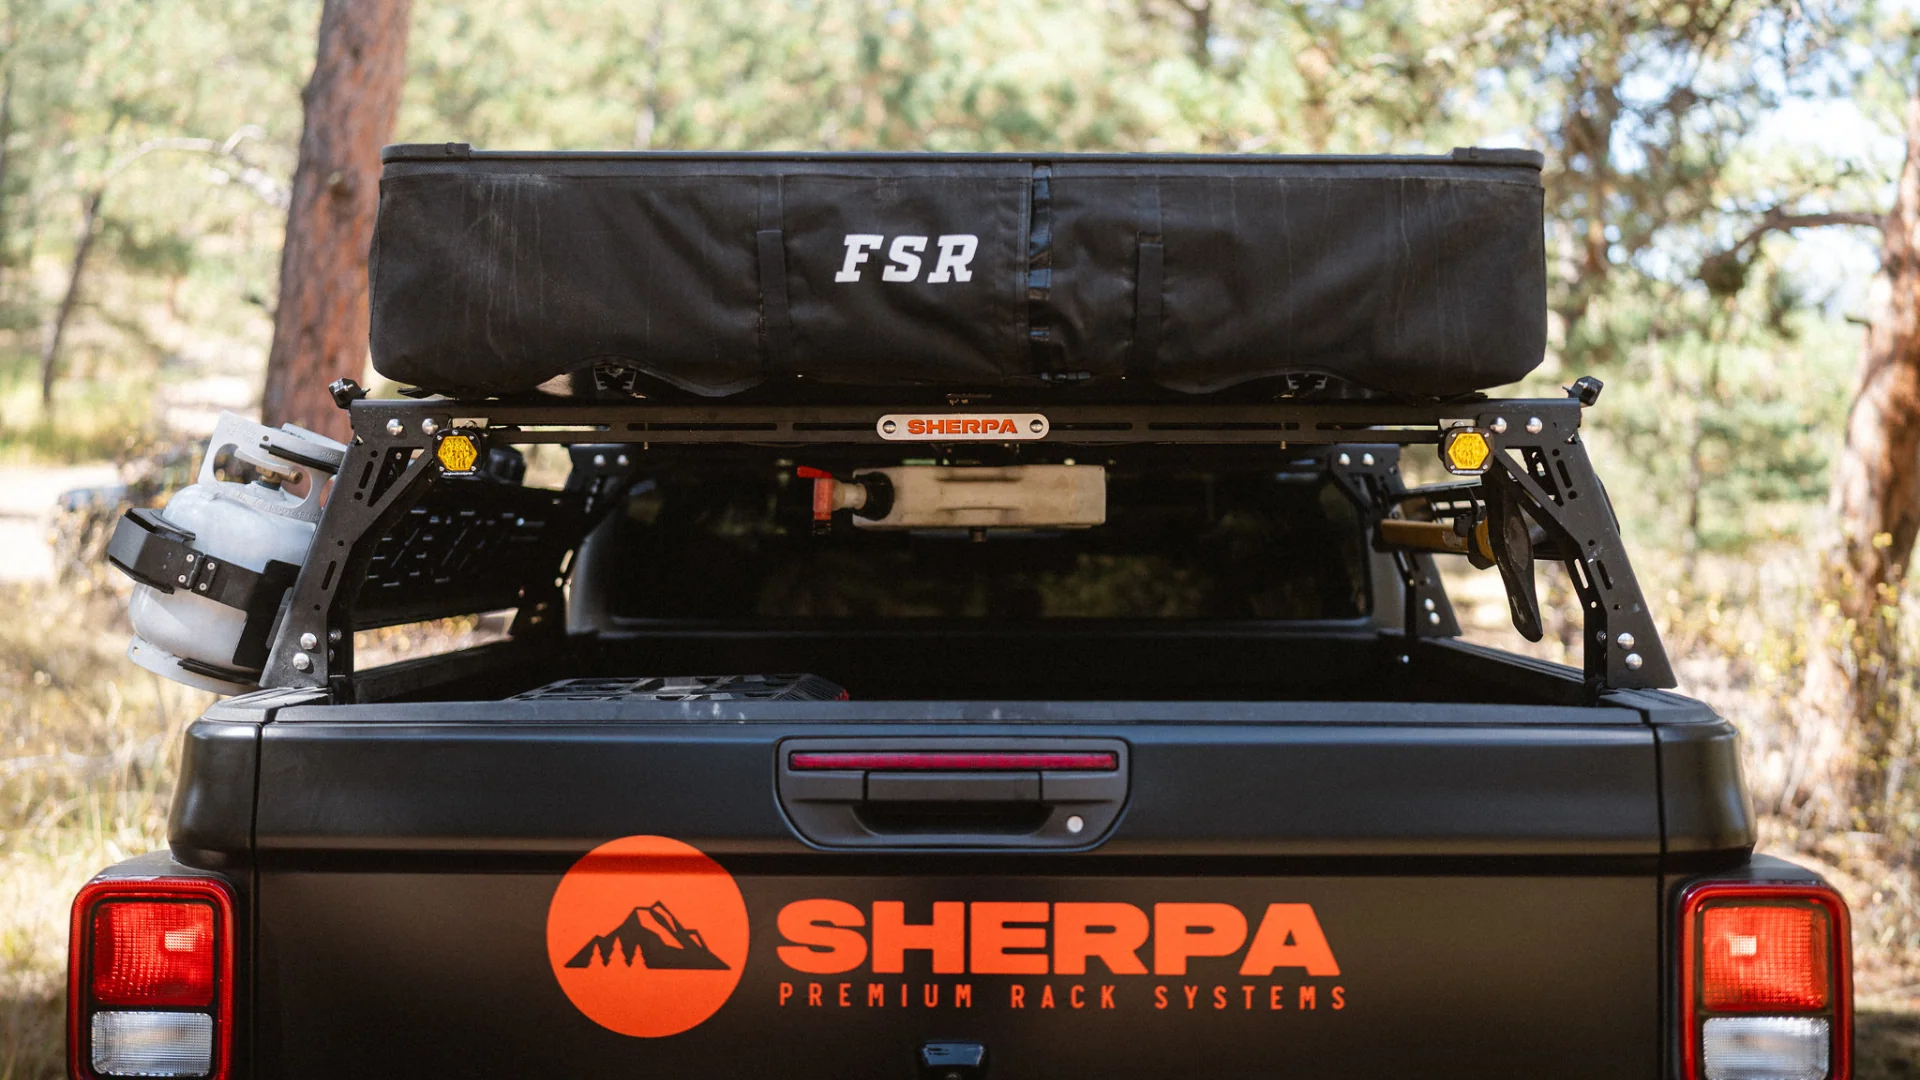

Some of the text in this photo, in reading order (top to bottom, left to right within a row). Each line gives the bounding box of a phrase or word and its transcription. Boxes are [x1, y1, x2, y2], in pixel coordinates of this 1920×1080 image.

[834, 233, 979, 284] FSR
[907, 418, 1018, 435] SHERPA
[776, 898, 1342, 977] SHERPA
[779, 982, 1346, 1011] PREMIUM RACK SYSTEMS
